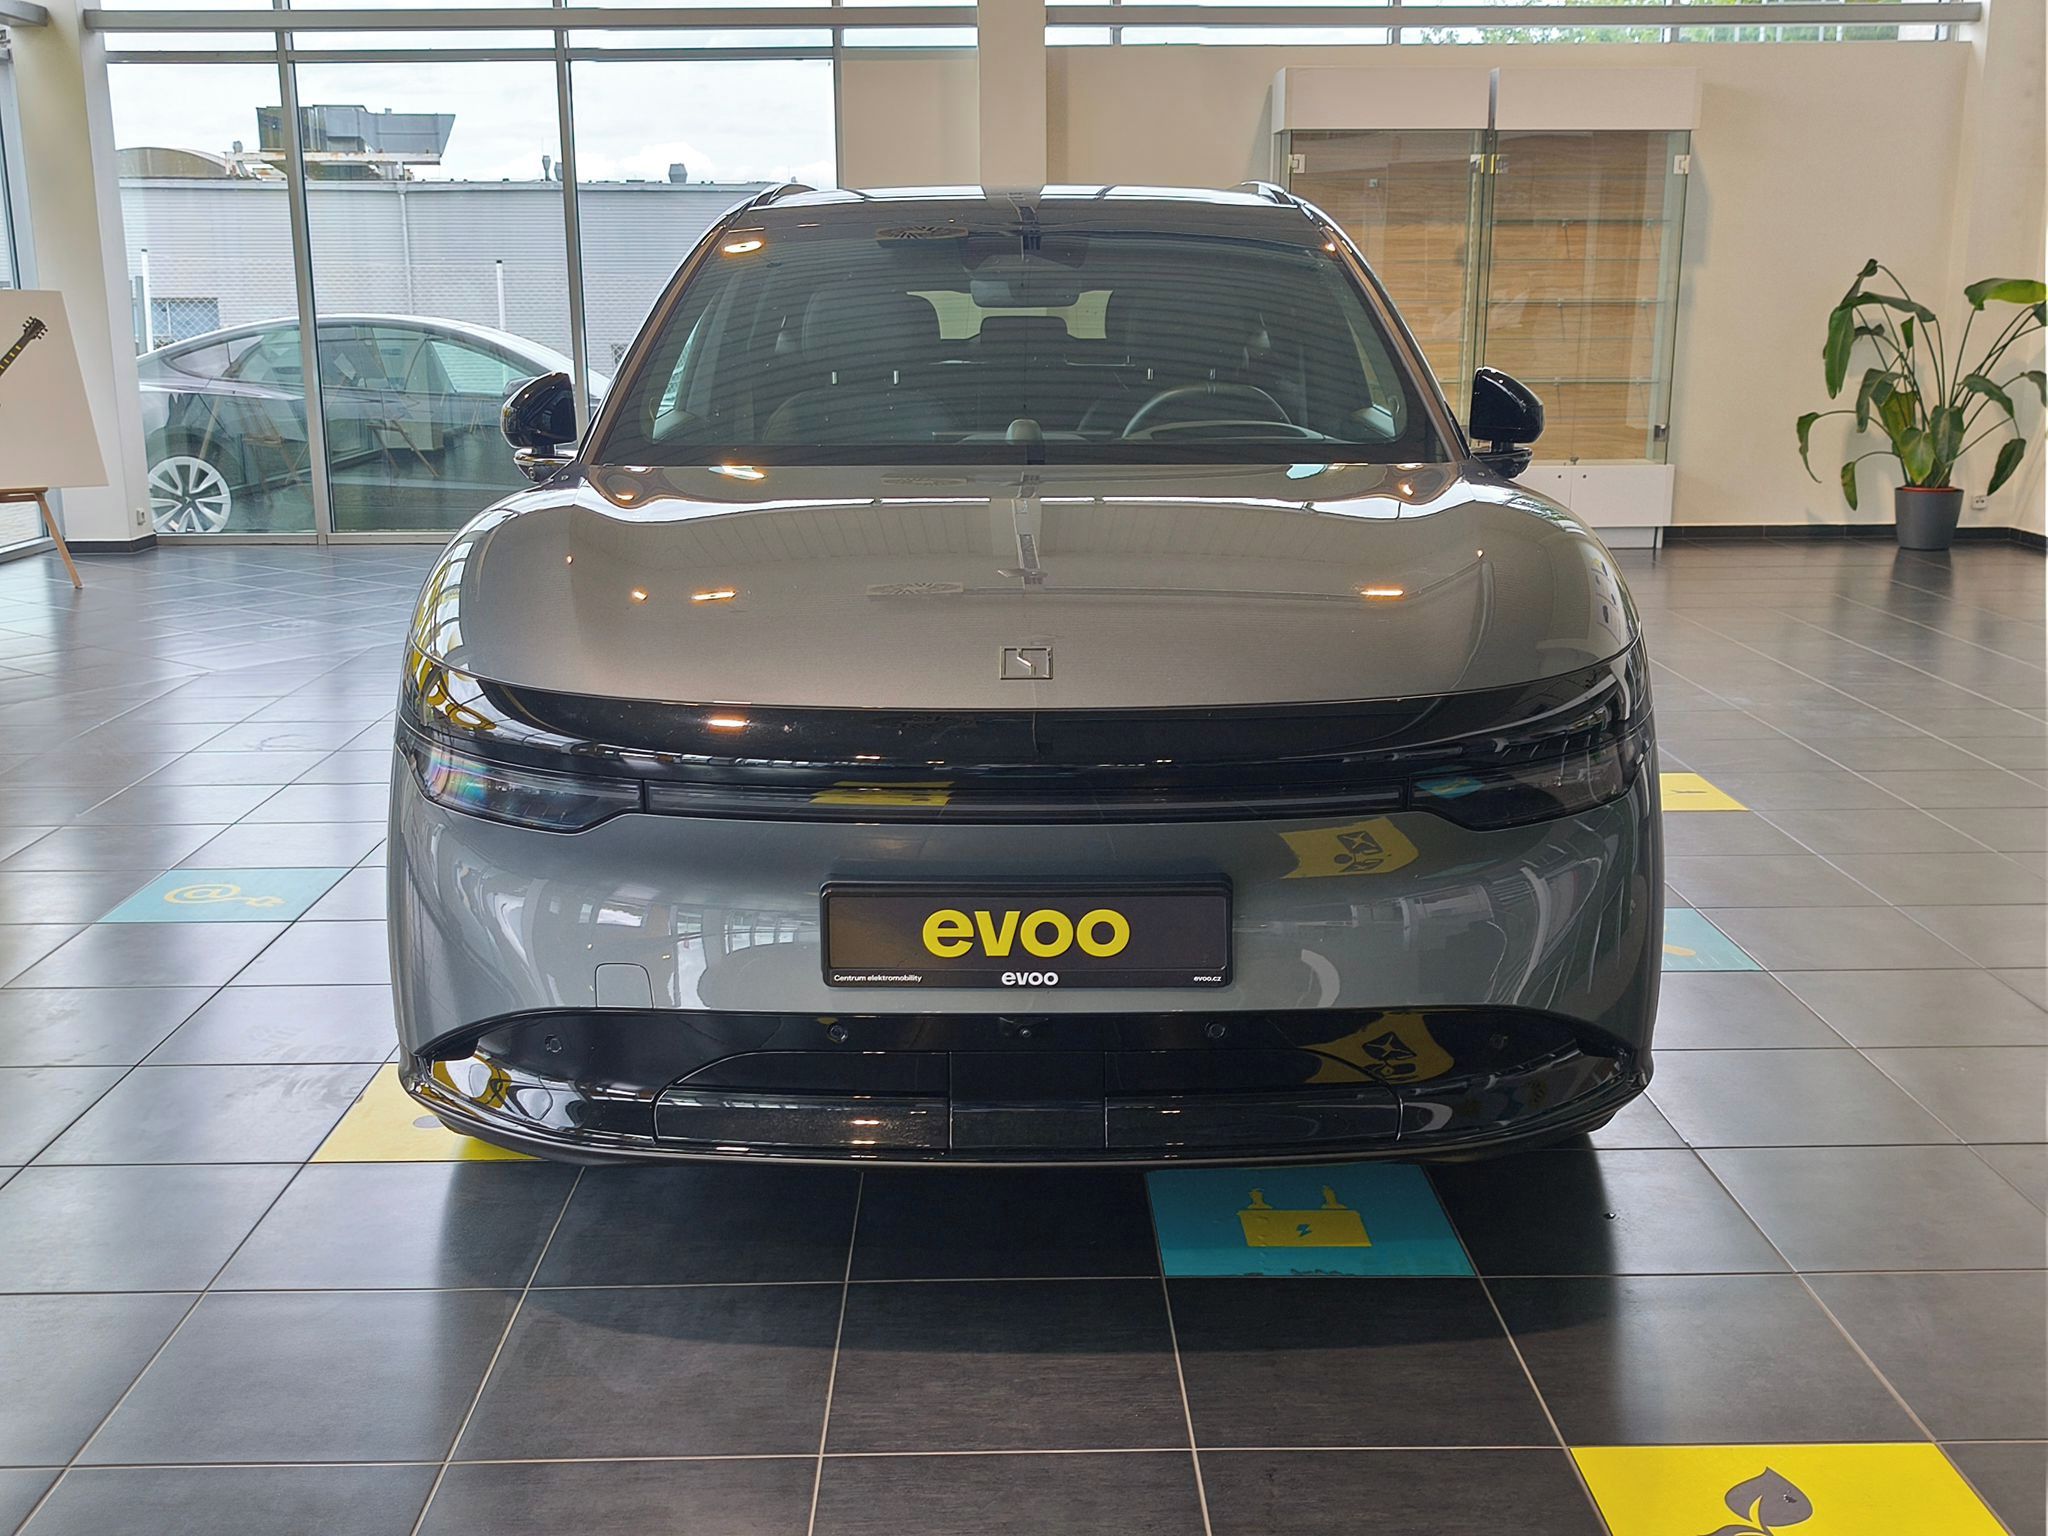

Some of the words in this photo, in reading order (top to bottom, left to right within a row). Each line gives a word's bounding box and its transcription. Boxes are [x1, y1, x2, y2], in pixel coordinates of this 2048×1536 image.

[922, 909, 1131, 958] evoo
[833, 974, 866, 982] Centrum
[867, 974, 923, 983] elektromobility
[1001, 971, 1059, 986] evoo
